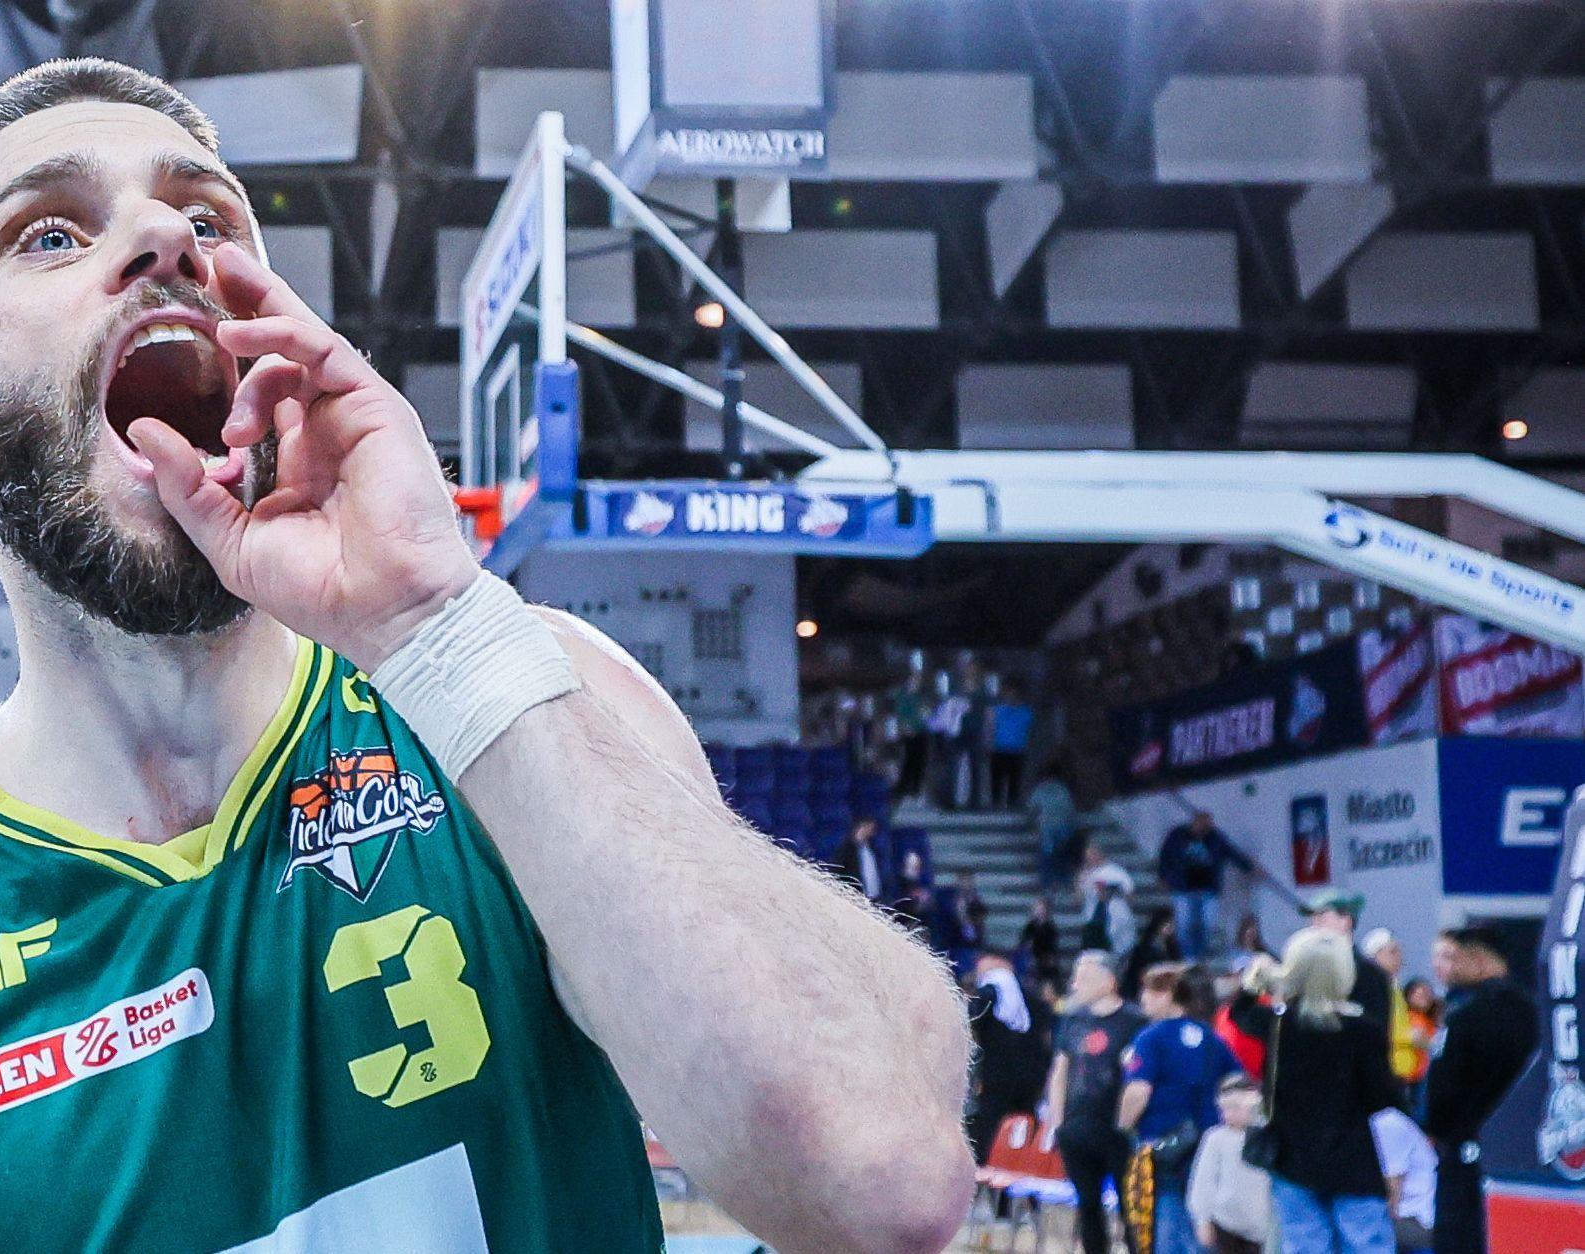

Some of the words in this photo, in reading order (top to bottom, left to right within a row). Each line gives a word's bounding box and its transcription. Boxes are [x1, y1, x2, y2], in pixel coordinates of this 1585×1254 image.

[655, 128, 826, 158] AEROWATCH
[685, 492, 785, 533] KING
[123, 978, 199, 1027] Basket
[322, 904, 492, 1109] 3
[128, 1016, 176, 1051] Liga
